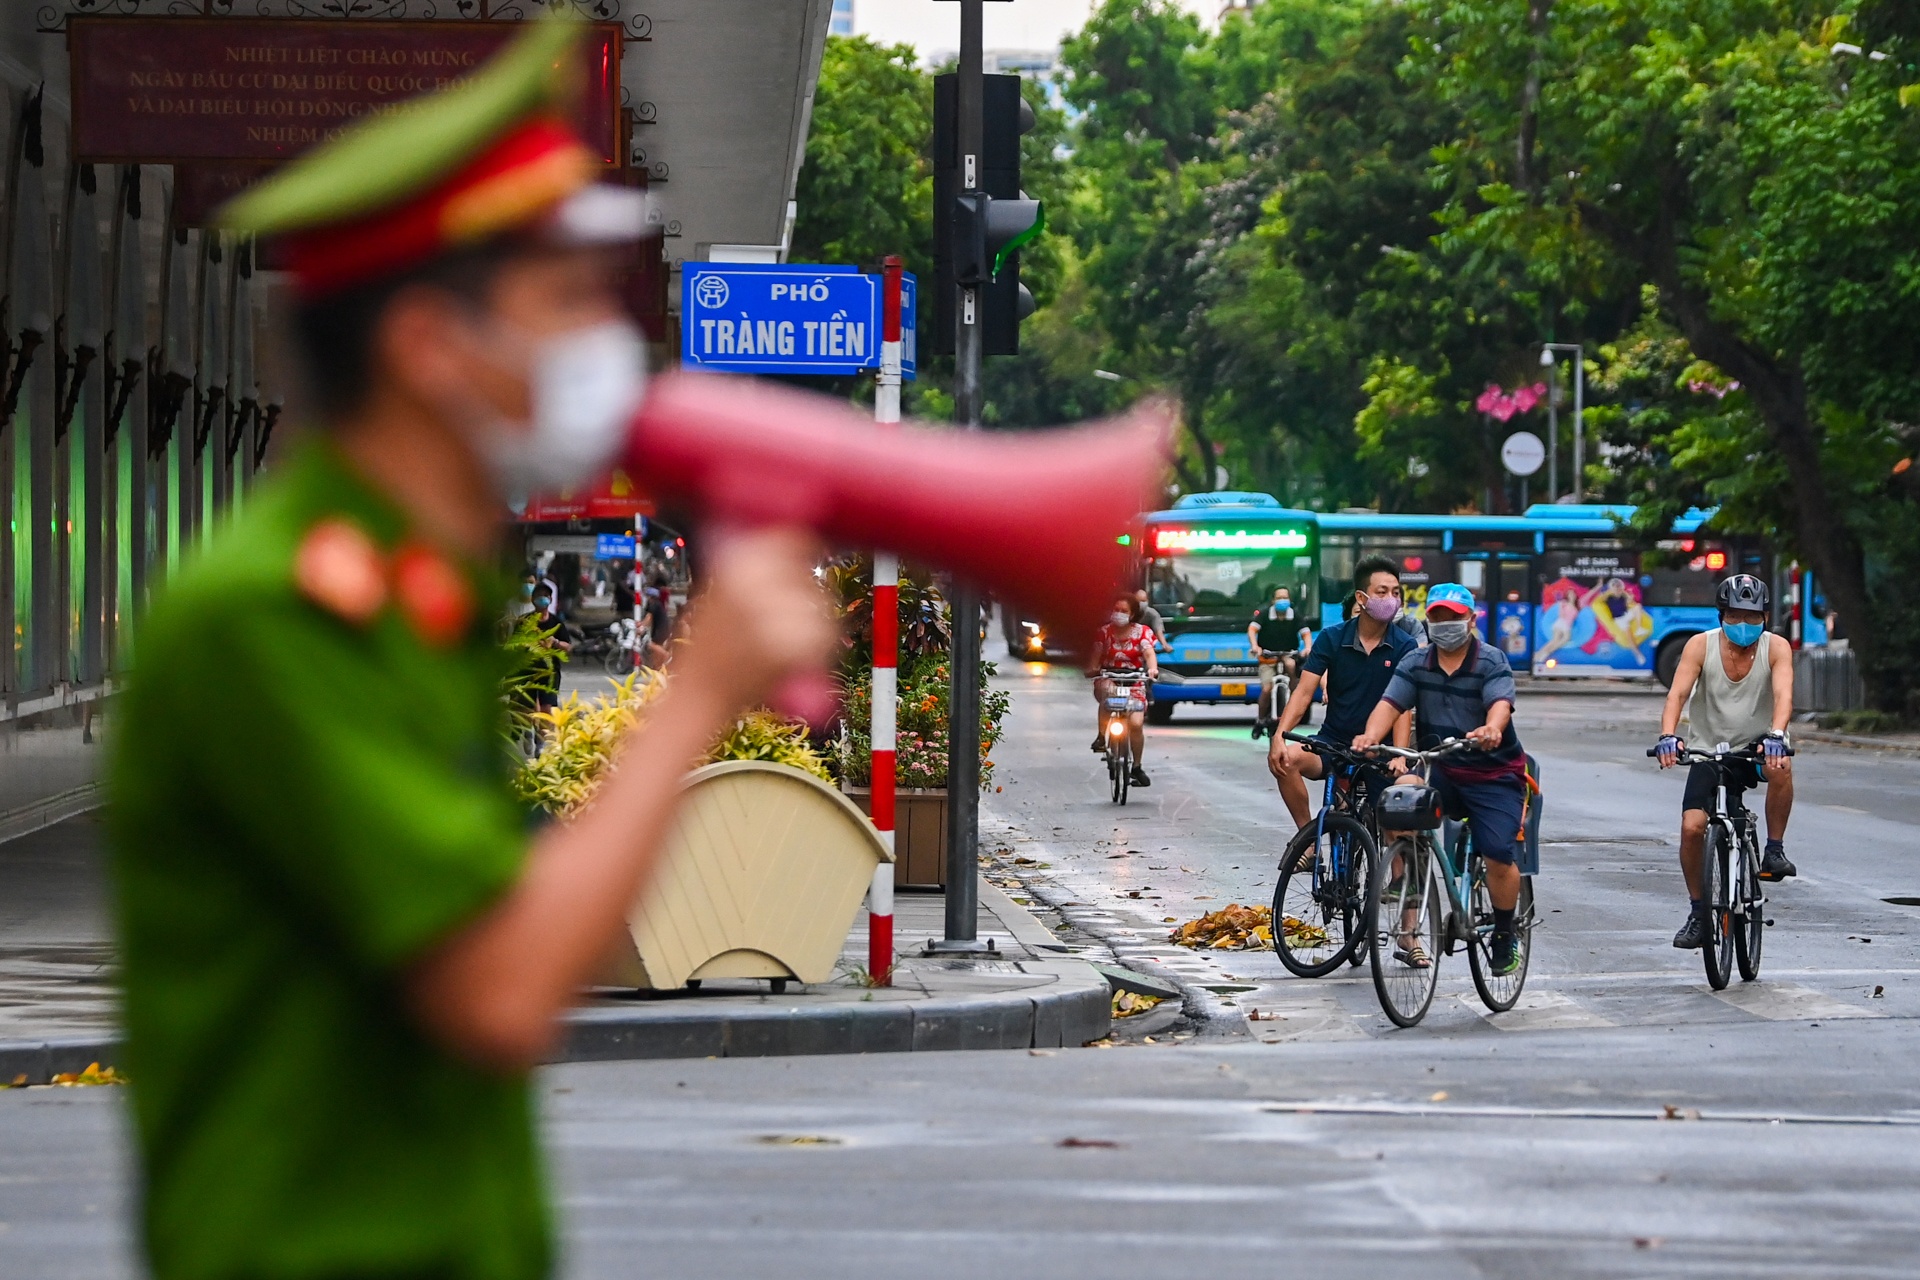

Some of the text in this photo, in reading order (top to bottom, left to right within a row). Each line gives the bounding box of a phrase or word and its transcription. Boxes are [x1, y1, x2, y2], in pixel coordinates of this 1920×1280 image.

[297, 45, 342, 66] LIỆT
[347, 46, 407, 66] CHÀO
[128, 68, 187, 89] NGÀY
[367, 72, 430, 94] QUỐC
[128, 94, 155, 113] VÀ
[254, 97, 298, 119] HỘI
[245, 124, 318, 145] NHIỆM
[771, 277, 831, 301] PHỐ
[701, 311, 795, 356] TRÀNG
[803, 309, 865, 357] TIỀN
